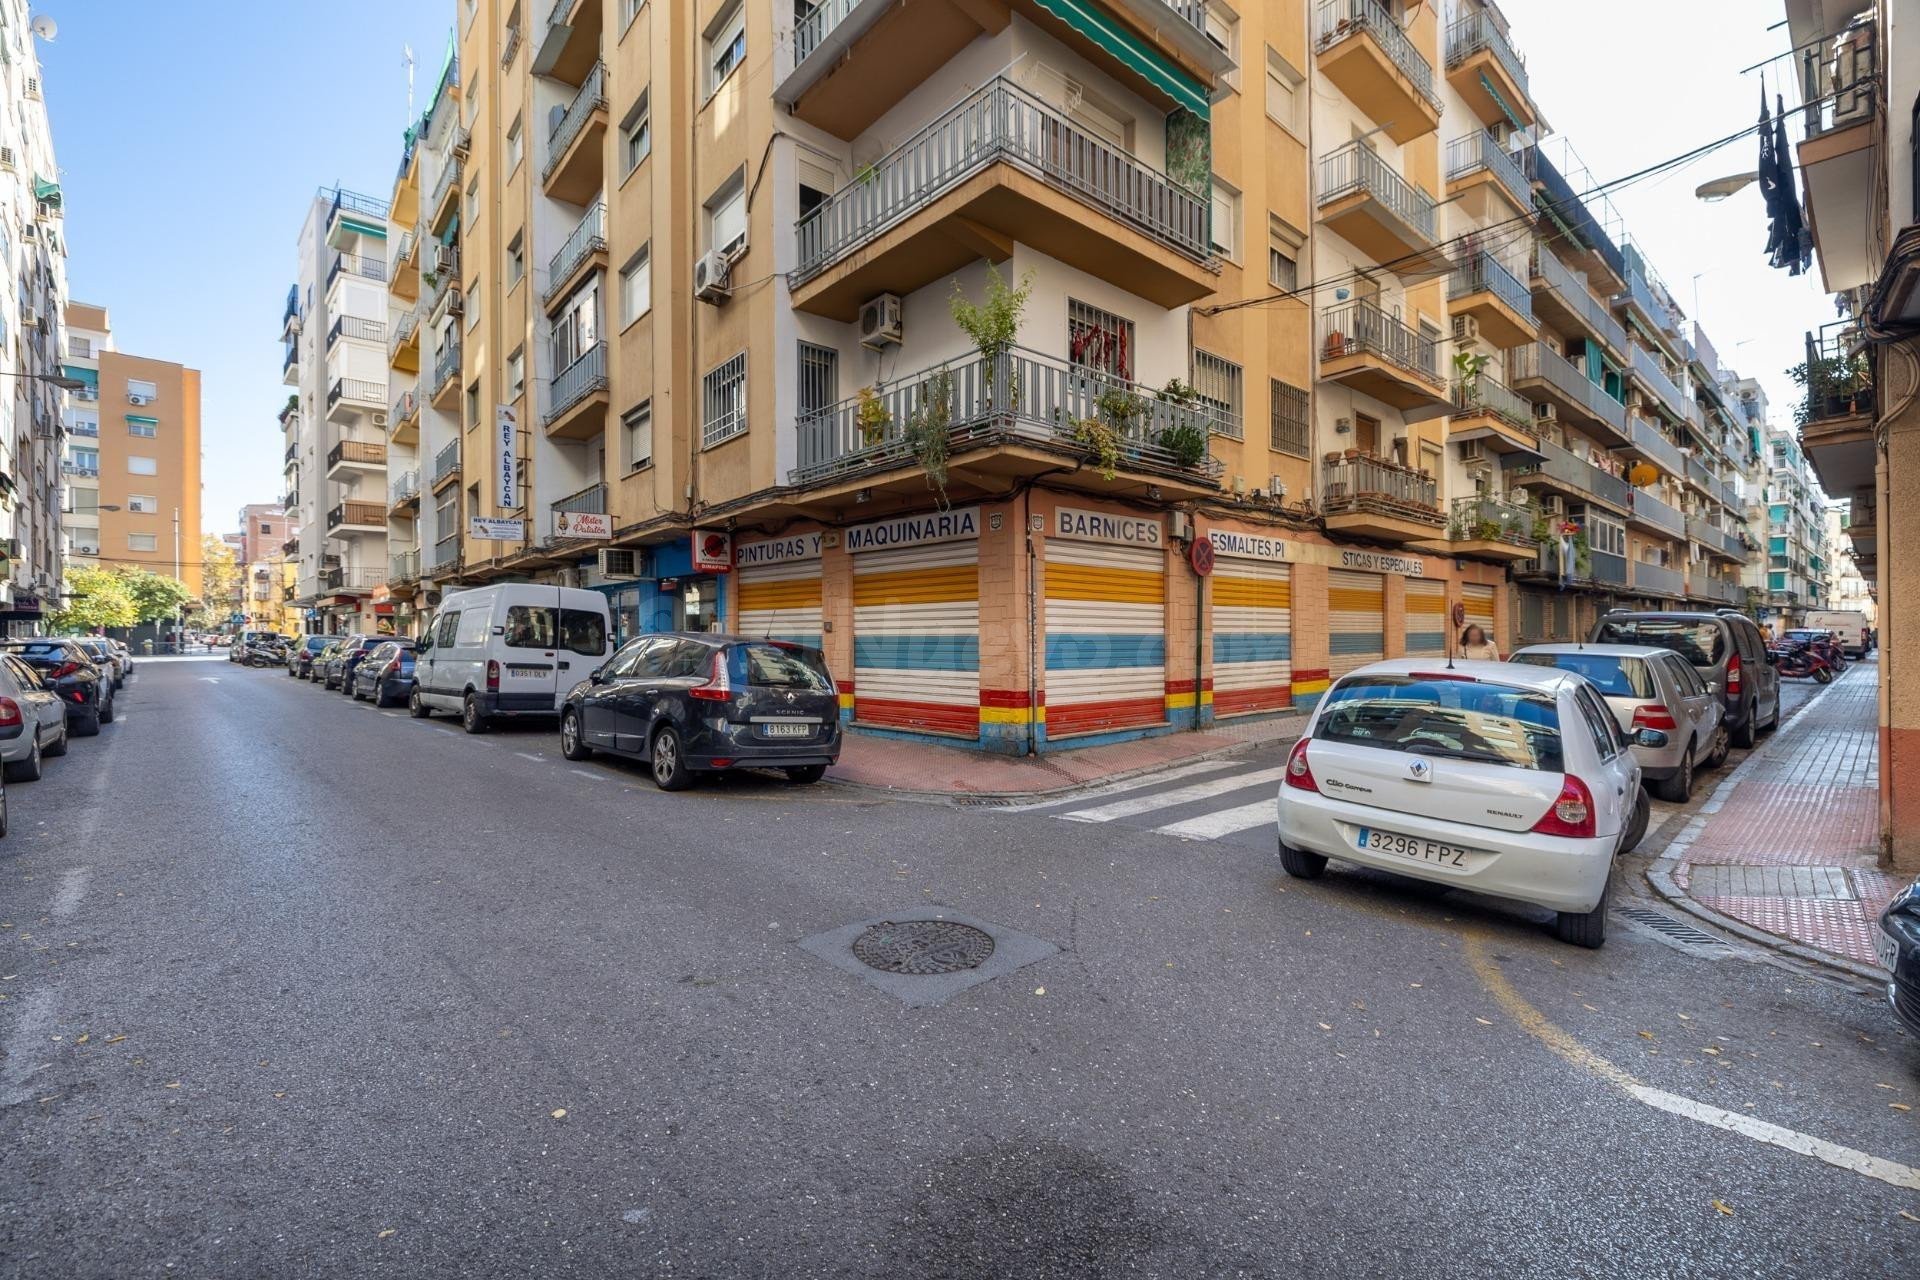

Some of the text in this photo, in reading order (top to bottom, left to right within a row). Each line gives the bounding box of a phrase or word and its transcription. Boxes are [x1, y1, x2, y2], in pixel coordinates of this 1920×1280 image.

[503, 425, 512, 507] REY ALBAYCAN
[488, 518, 522, 526] ALBAYCAN
[576, 514, 603, 525] Mister
[848, 513, 975, 549] MAQUINARIA
[1060, 512, 1158, 543] BARNICES
[737, 539, 804, 564] PINTURAS
[811, 536, 823, 554] Y
[1343, 551, 1372, 568] STICAS
[1381, 557, 1422, 575] ESPECIALES
[769, 725, 791, 733] 8163
[1487, 809, 1523, 819] RENAULT
[1371, 833, 1418, 856] 3296
[1425, 843, 1465, 867] FPZ
